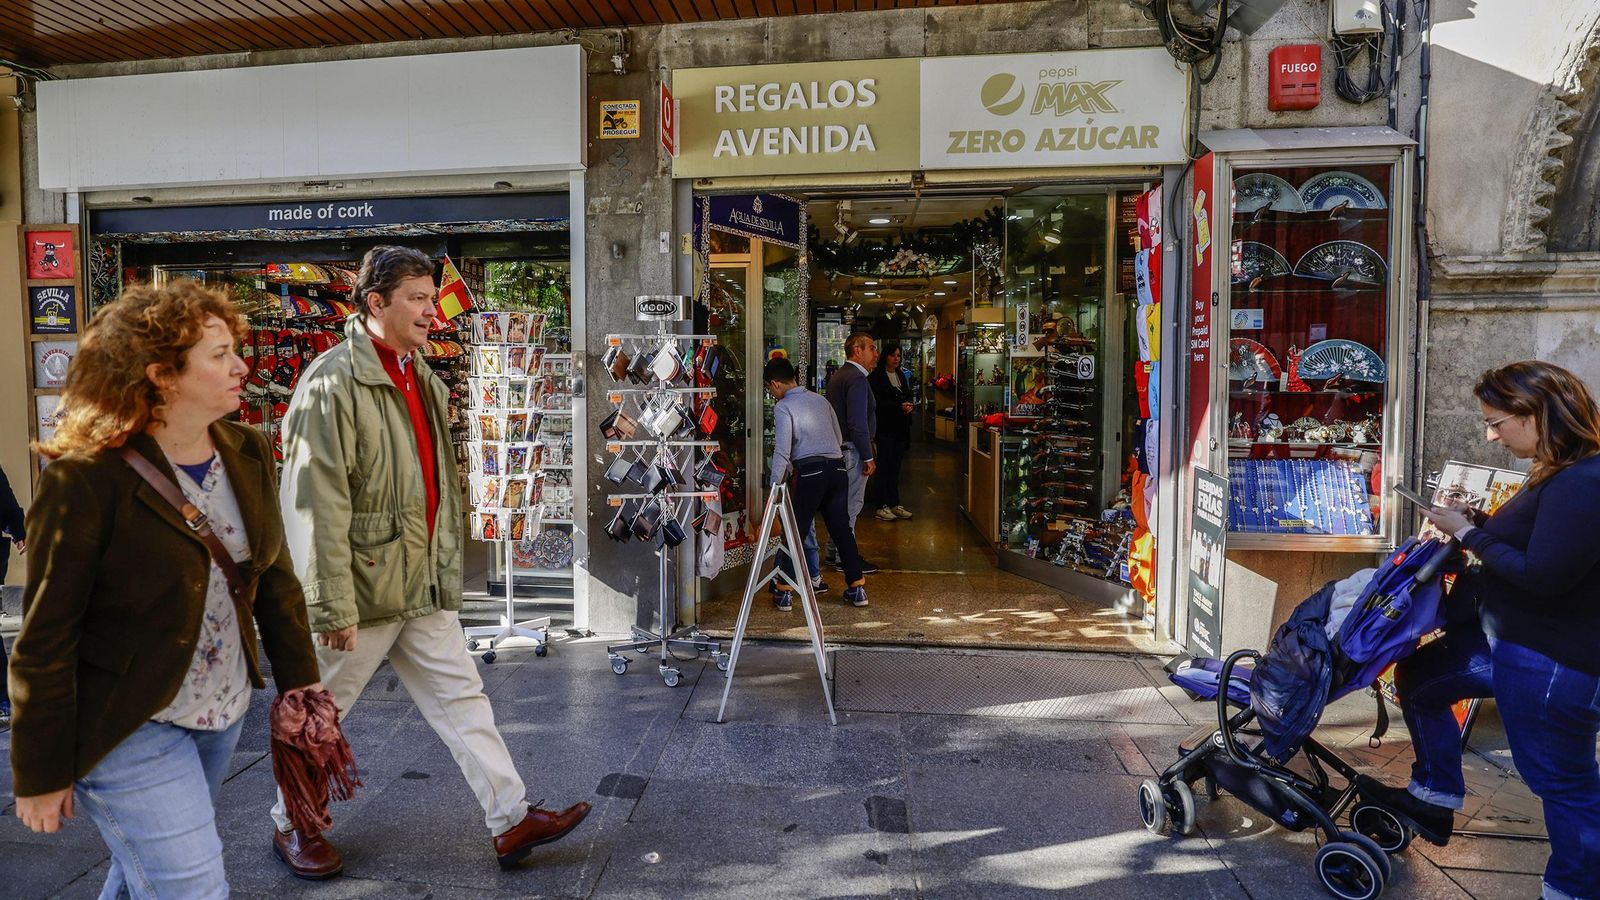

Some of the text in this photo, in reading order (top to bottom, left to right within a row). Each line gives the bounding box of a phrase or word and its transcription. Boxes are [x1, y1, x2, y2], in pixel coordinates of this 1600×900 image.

[1038, 65, 1077, 80] pepsi
[1281, 62, 1317, 74] FUEGO
[714, 78, 877, 114] REGALOS
[1030, 79, 1125, 117] MAX
[602, 103, 637, 111] CONECTADA
[712, 122, 877, 158] AVENIDA
[946, 117, 1160, 154] ZERO AZÚCAR
[268, 202, 374, 221] made of cork
[728, 207, 785, 236] AGUA DE SEVILLA
[36, 287, 70, 304] SEVILLA
[639, 303, 673, 312] MOON
[1195, 300, 1205, 311] Buy
[1194, 314, 1205, 325] your
[1192, 325, 1208, 338] Prepaid
[1190, 338, 1209, 349] SIM Card
[40, 348, 73, 364] UNIVERSIDA
[1193, 352, 1204, 362] here
